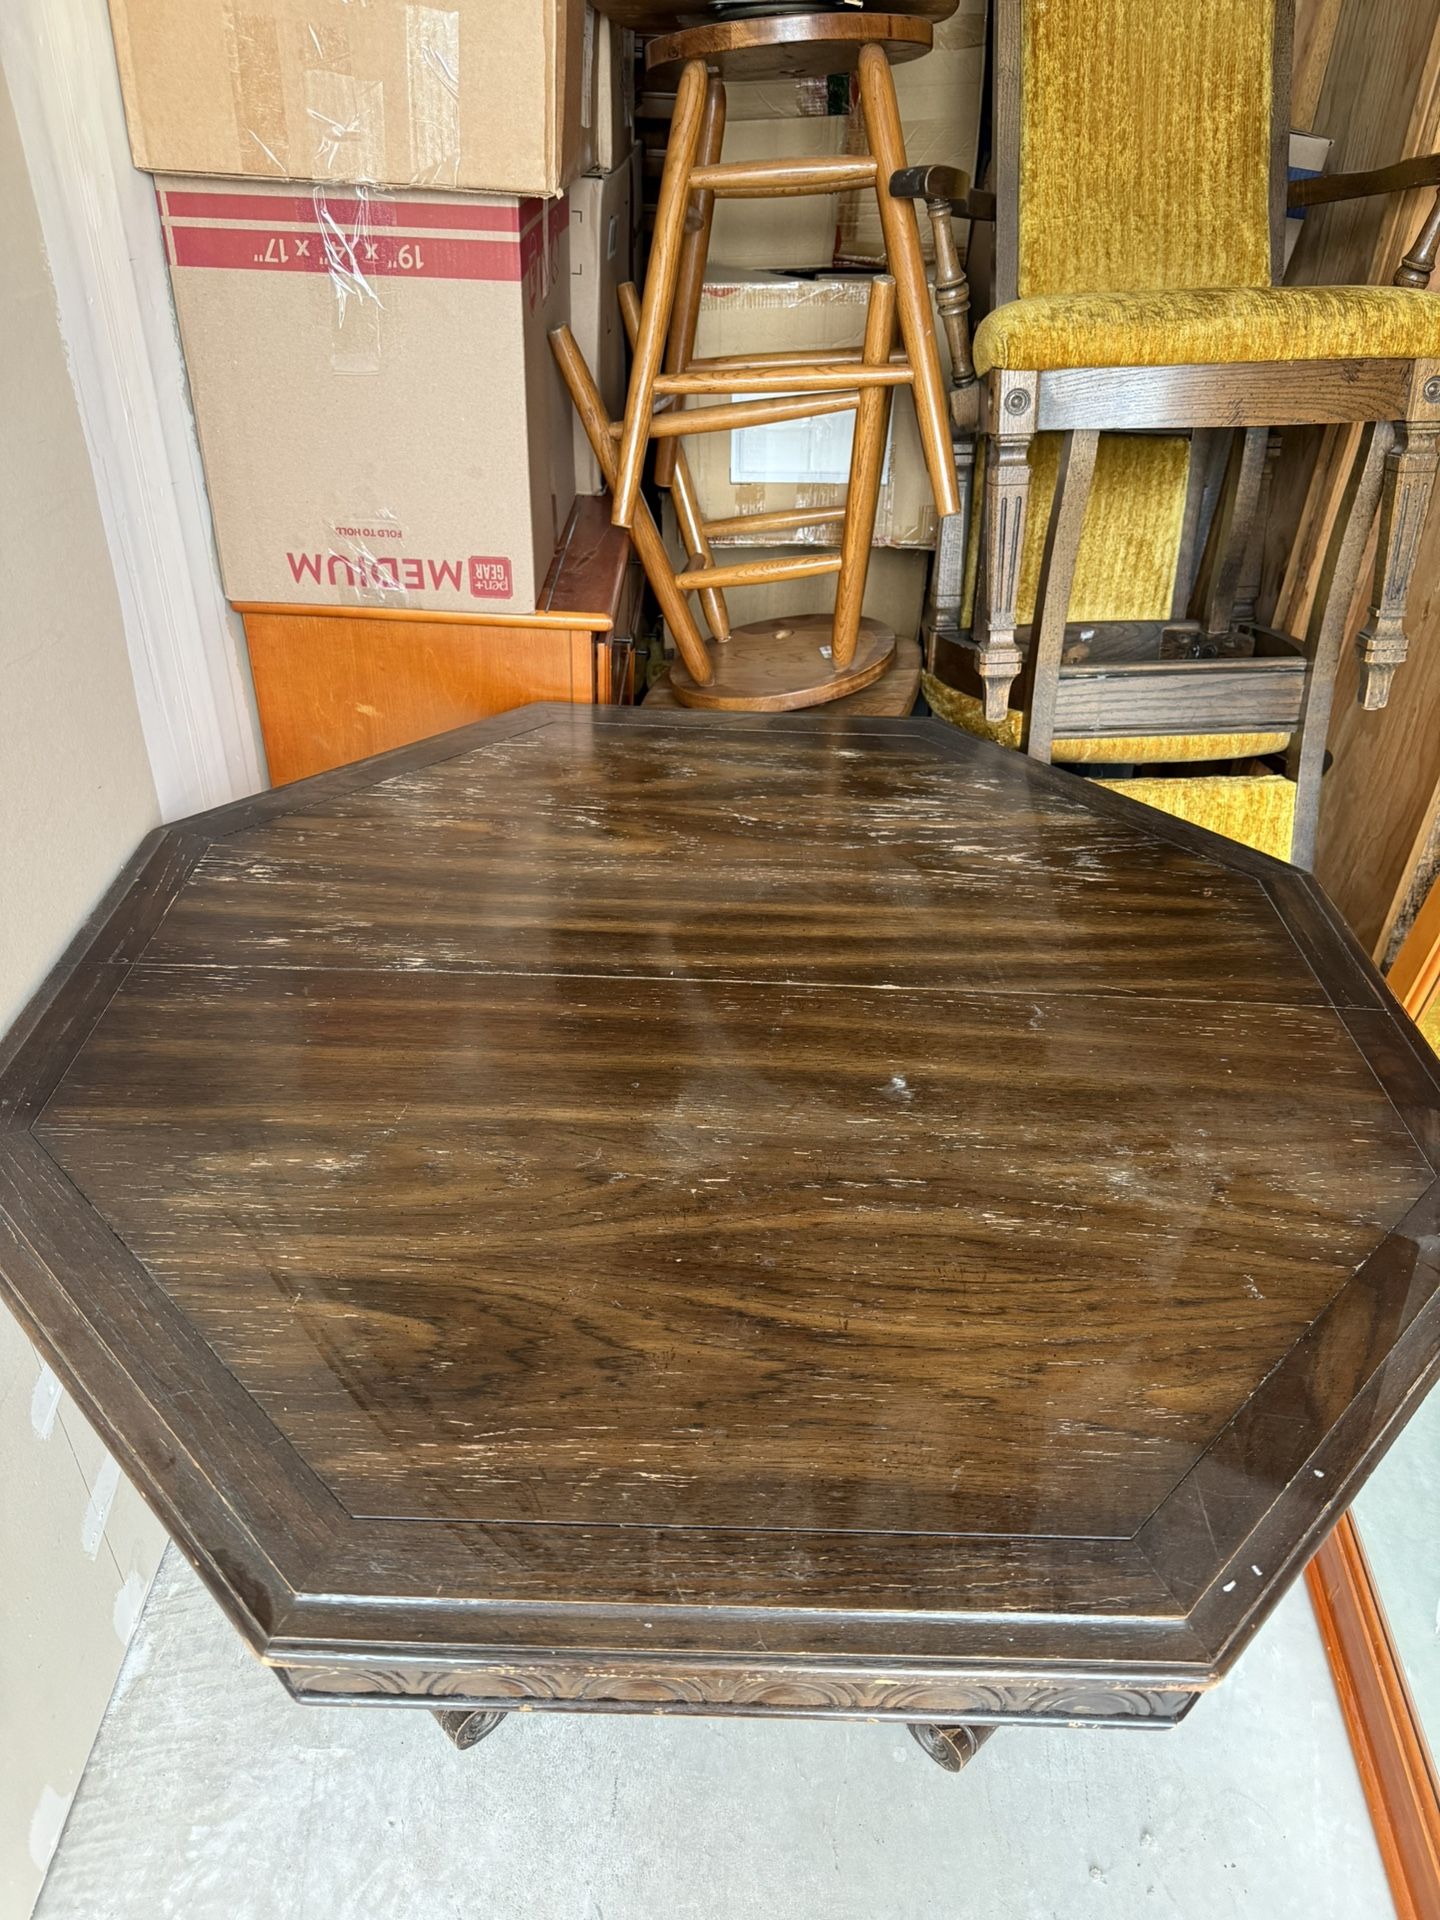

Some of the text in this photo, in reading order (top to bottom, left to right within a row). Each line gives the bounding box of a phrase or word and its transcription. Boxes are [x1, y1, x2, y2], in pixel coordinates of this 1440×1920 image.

[253, 238, 289, 263] 17"
[295, 239, 310, 257] x
[365, 242, 379, 260] x
[387, 244, 425, 270] 19"
[363, 528, 376, 537] TO
[377, 529, 402, 539] FOLD
[286, 552, 463, 592] MEDIUM
[475, 563, 504, 581] GEAR
[475, 576, 509, 591] pen+
